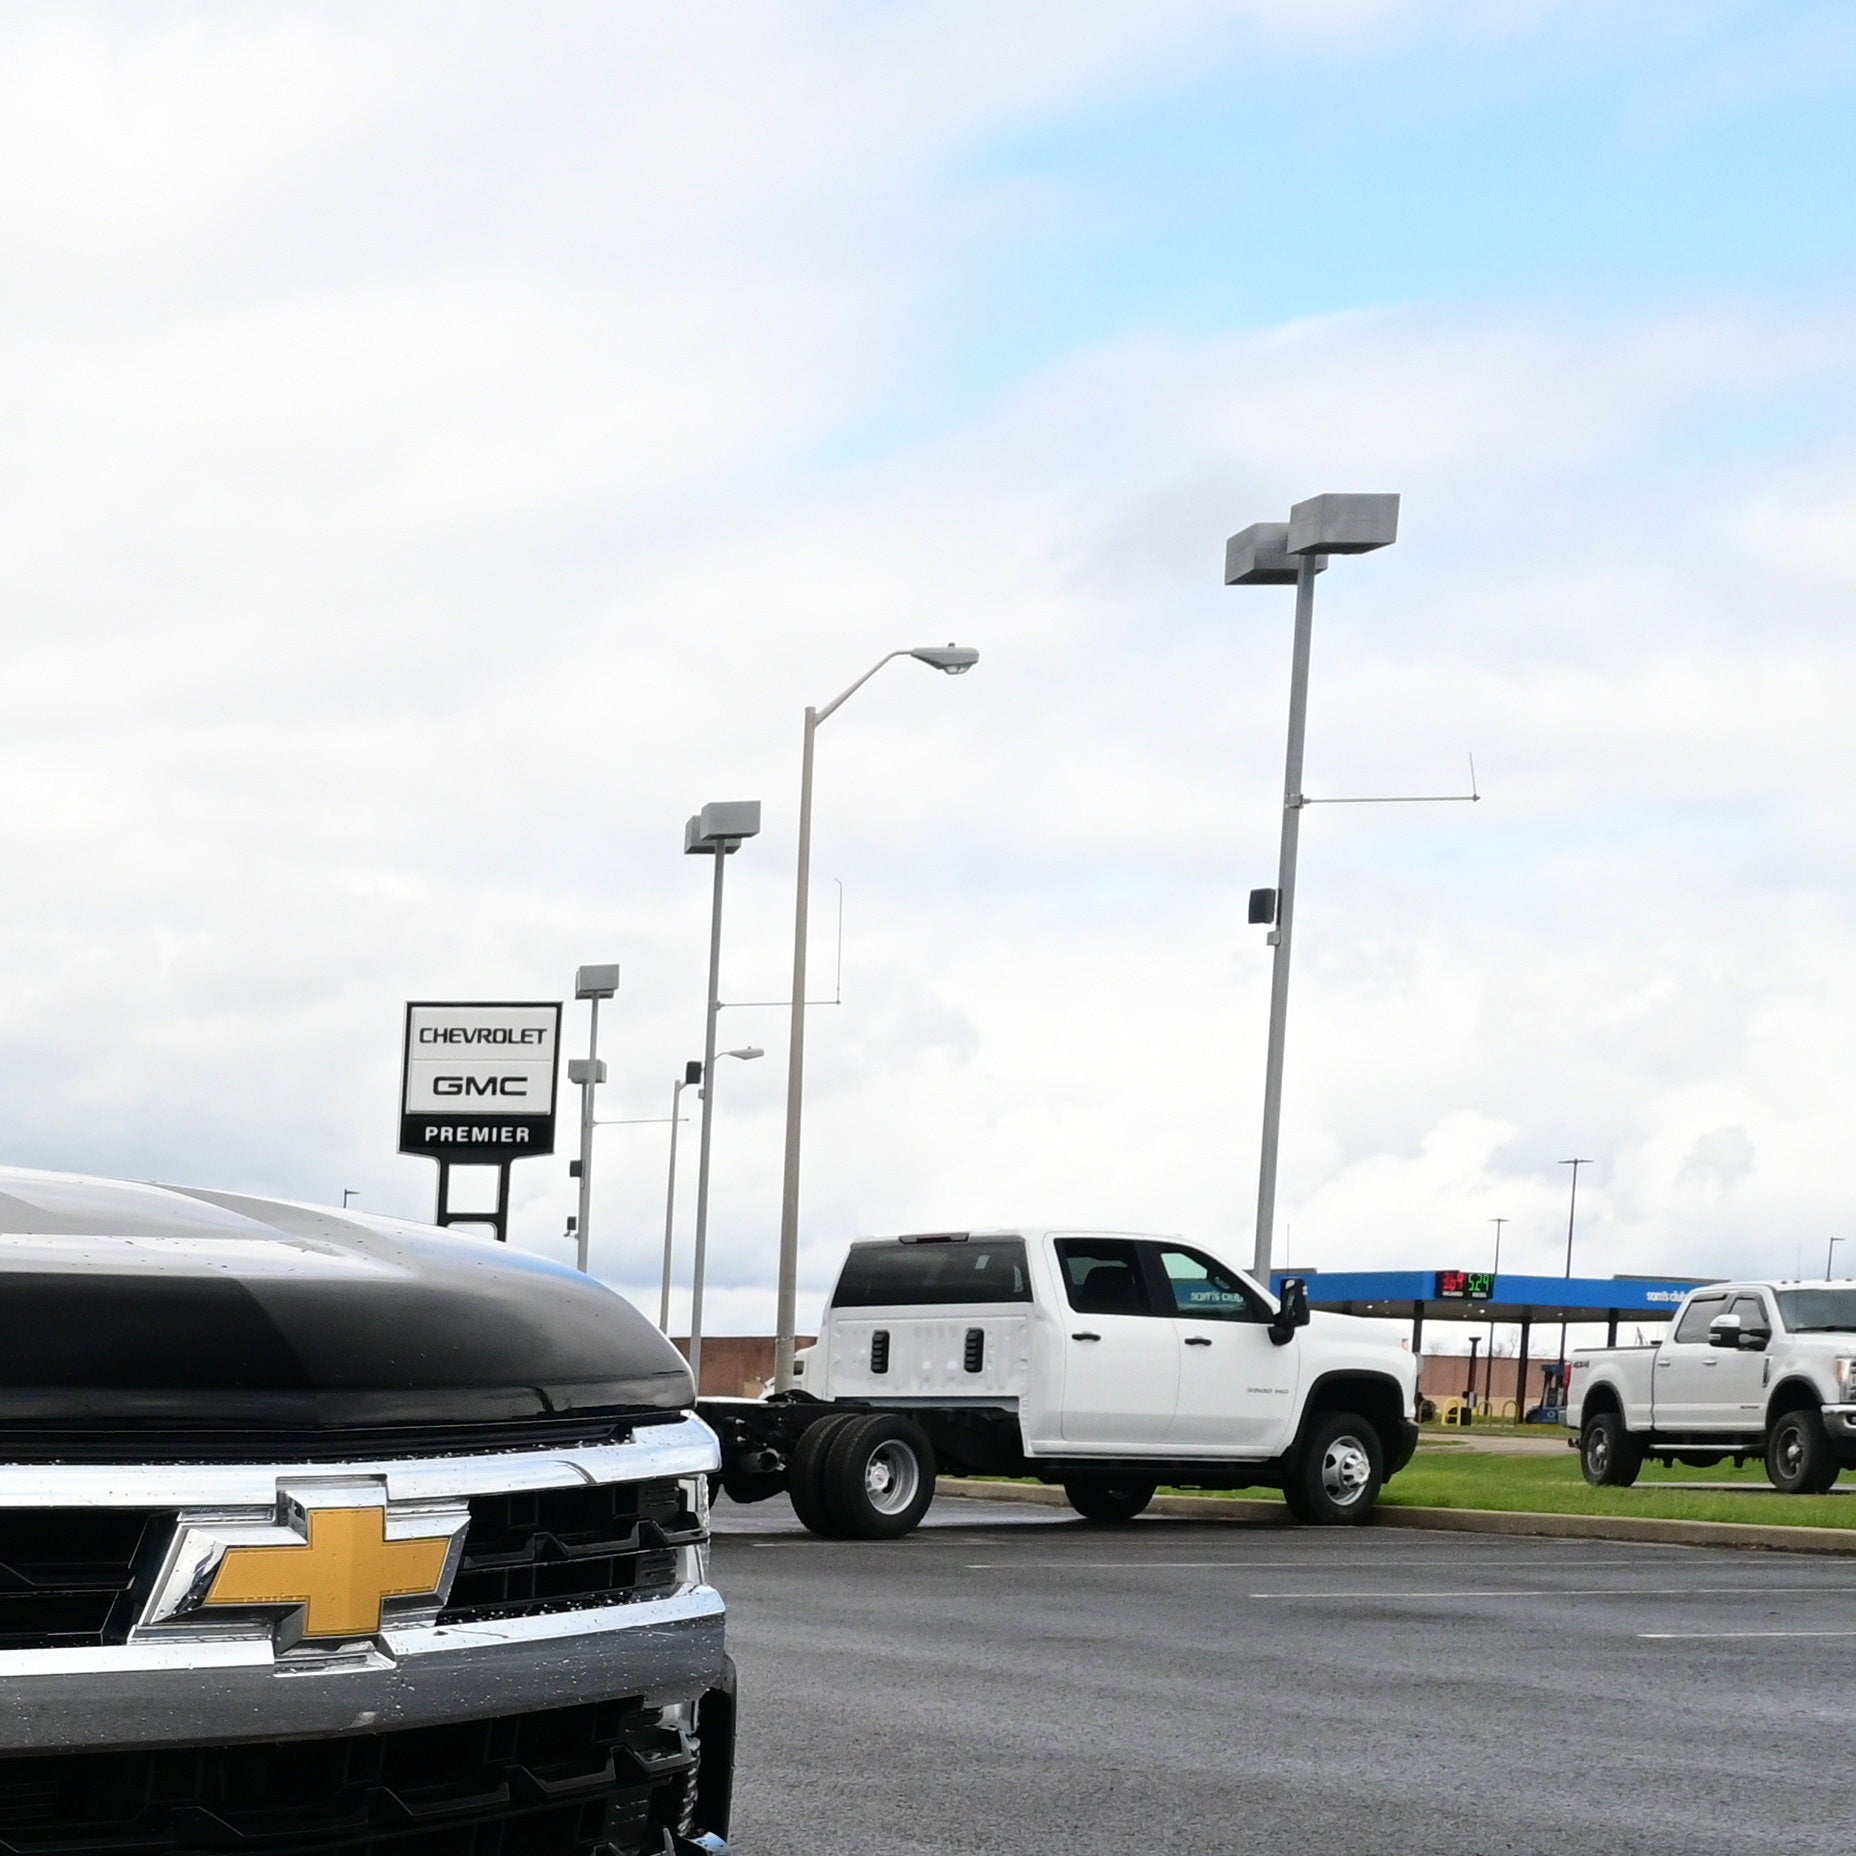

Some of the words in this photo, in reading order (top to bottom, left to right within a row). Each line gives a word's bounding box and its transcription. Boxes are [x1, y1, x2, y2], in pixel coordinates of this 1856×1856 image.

[418, 1027, 548, 1045] CHEVROLET
[432, 1076, 528, 1096] GMC
[424, 1126, 530, 1143] PREMIER
